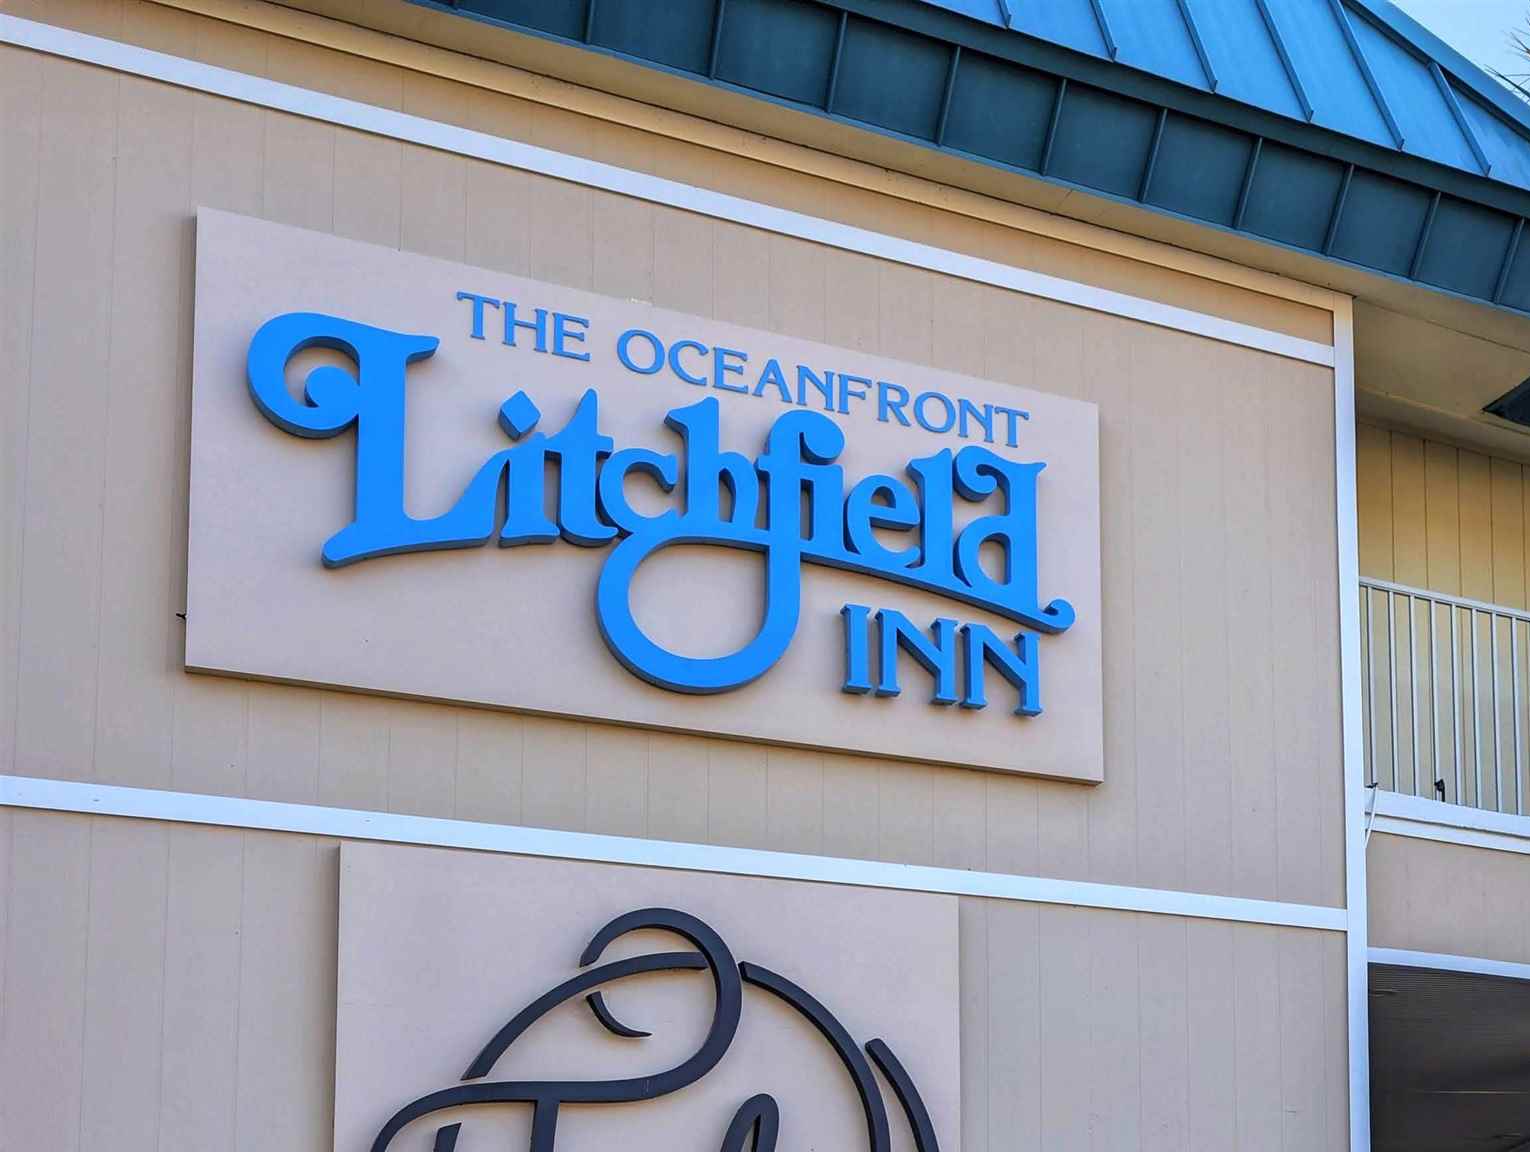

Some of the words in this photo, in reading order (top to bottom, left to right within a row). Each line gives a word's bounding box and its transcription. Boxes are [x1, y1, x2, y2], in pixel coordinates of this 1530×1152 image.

[457, 291, 591, 362] THE
[616, 328, 1030, 448] OCEANFRONT
[246, 312, 1077, 695] Litchfield
[840, 603, 1044, 718] INN
